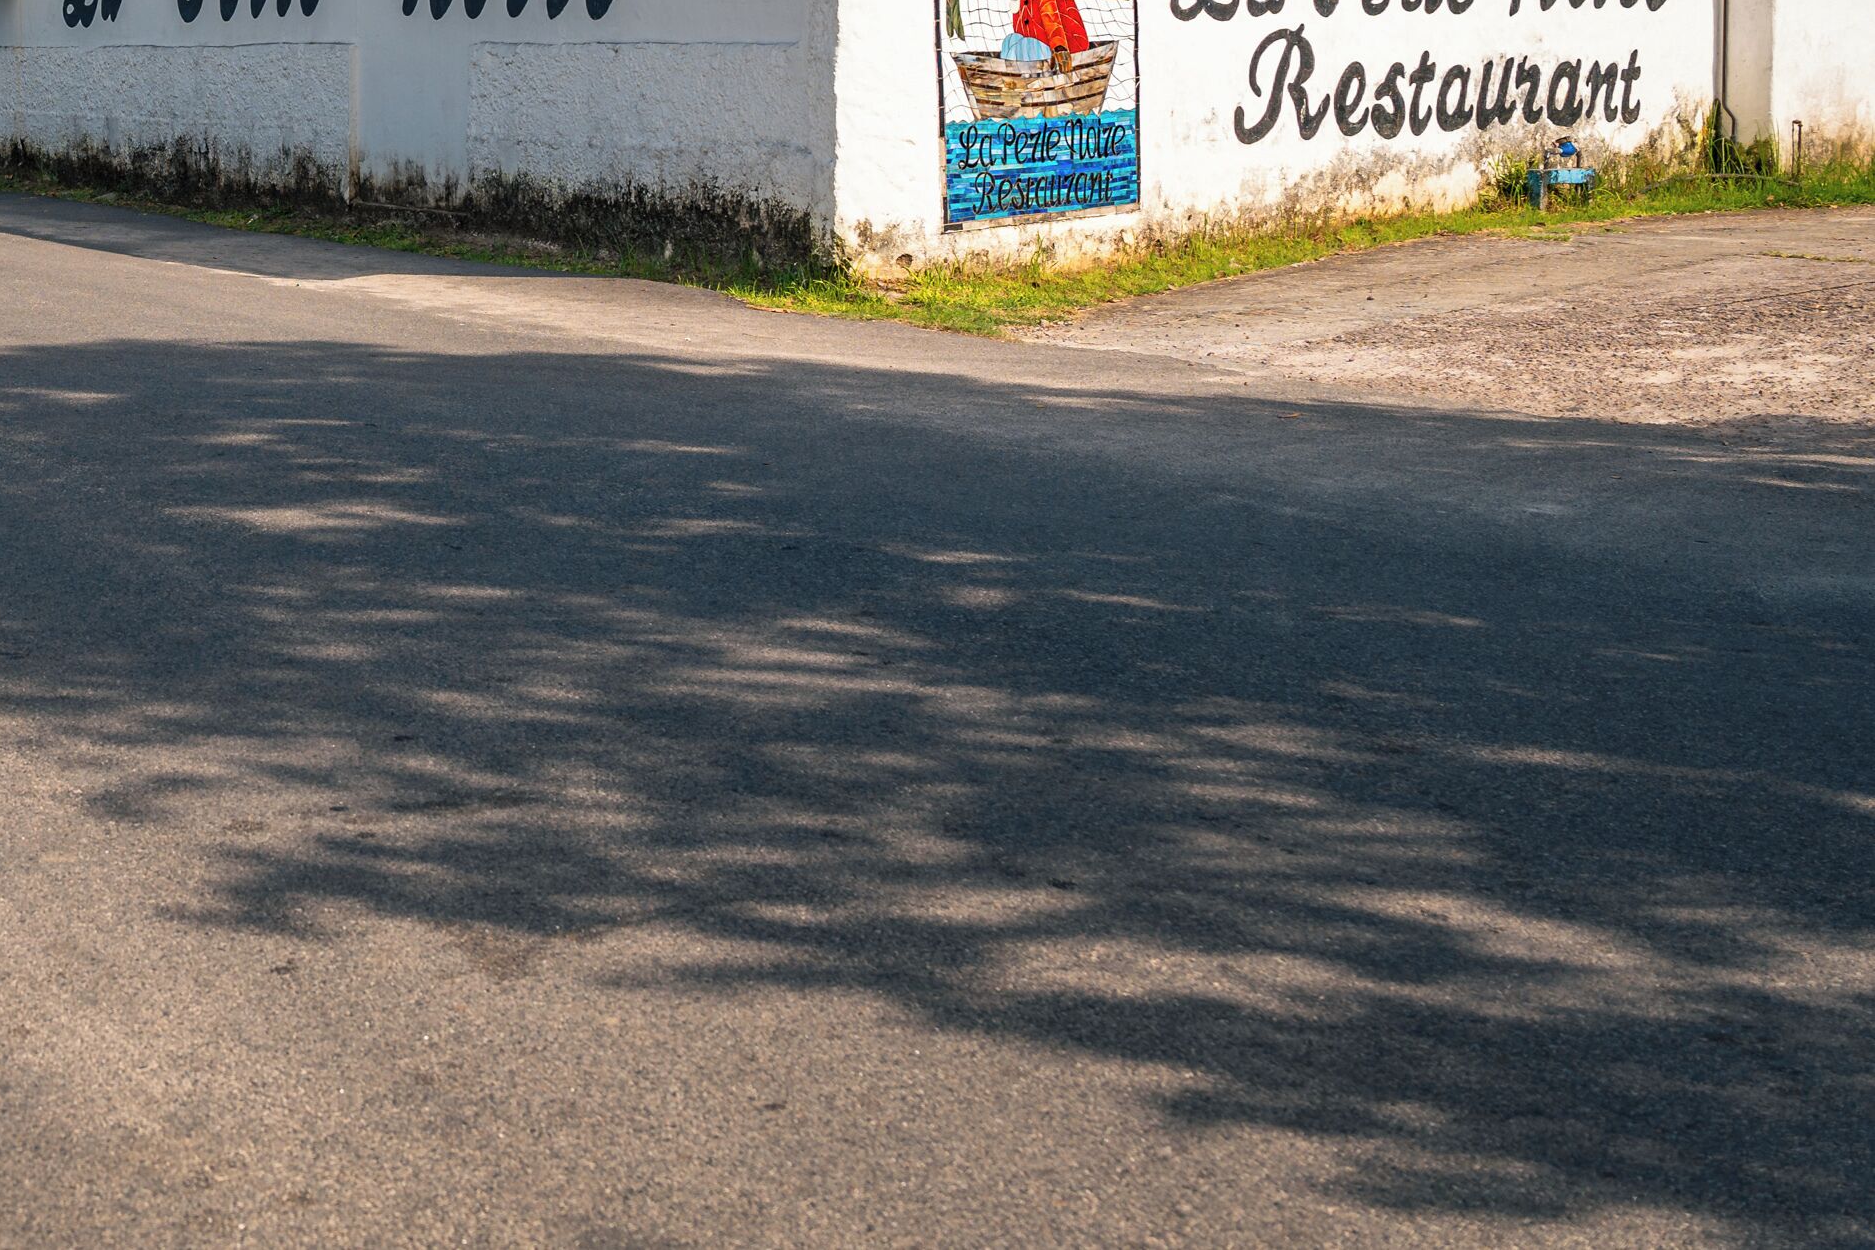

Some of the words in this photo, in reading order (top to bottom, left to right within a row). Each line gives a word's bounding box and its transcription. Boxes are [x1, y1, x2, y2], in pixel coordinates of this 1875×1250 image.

[1233, 23, 1642, 144] Restaurant
[958, 125, 997, 170] La
[998, 122, 1061, 165] Perle
[1064, 118, 1125, 160] Noire
[972, 170, 1114, 215] Restaurant
